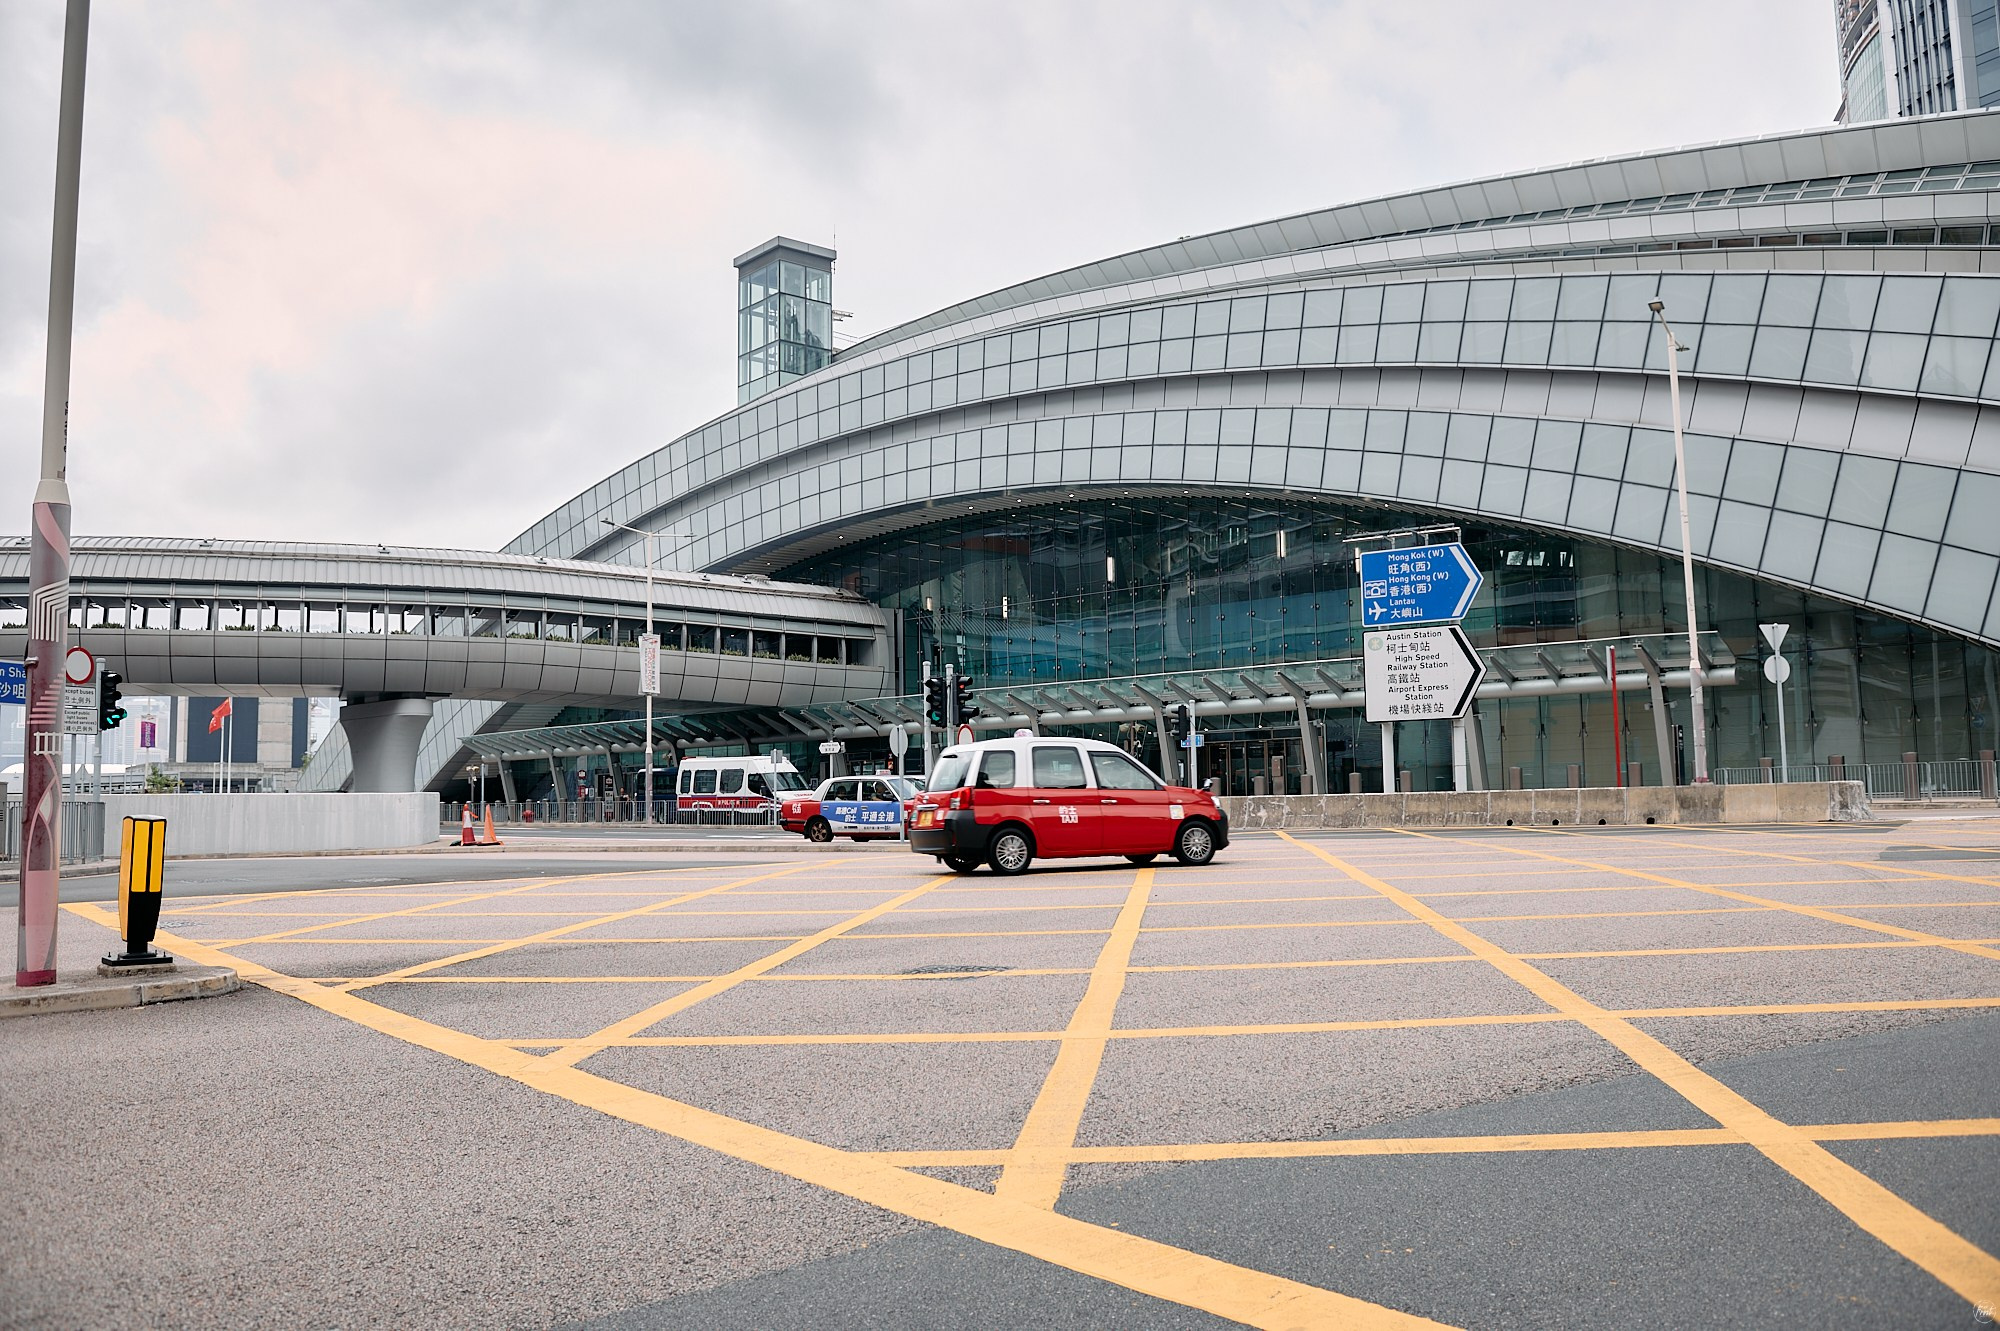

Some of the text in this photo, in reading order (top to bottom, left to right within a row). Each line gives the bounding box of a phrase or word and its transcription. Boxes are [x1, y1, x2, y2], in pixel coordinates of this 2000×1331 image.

[1388, 548, 1444, 563] Mong Kok (W)
[1388, 561, 1431, 574] 旺角(西)
[1389, 572, 1449, 585] Hong Kong (W)
[1389, 583, 1432, 597] 香港(西)
[1390, 607, 1423, 619] 大嶼山
[1386, 641, 1430, 654] 柯士甸站
[1395, 653, 1440, 662] High Speed
[1388, 673, 1420, 684] 高鐵站
[1388, 684, 1448, 694] Airport Express
[1058, 806, 1077, 814] 的士
[1059, 815, 1078, 824] TAXI
